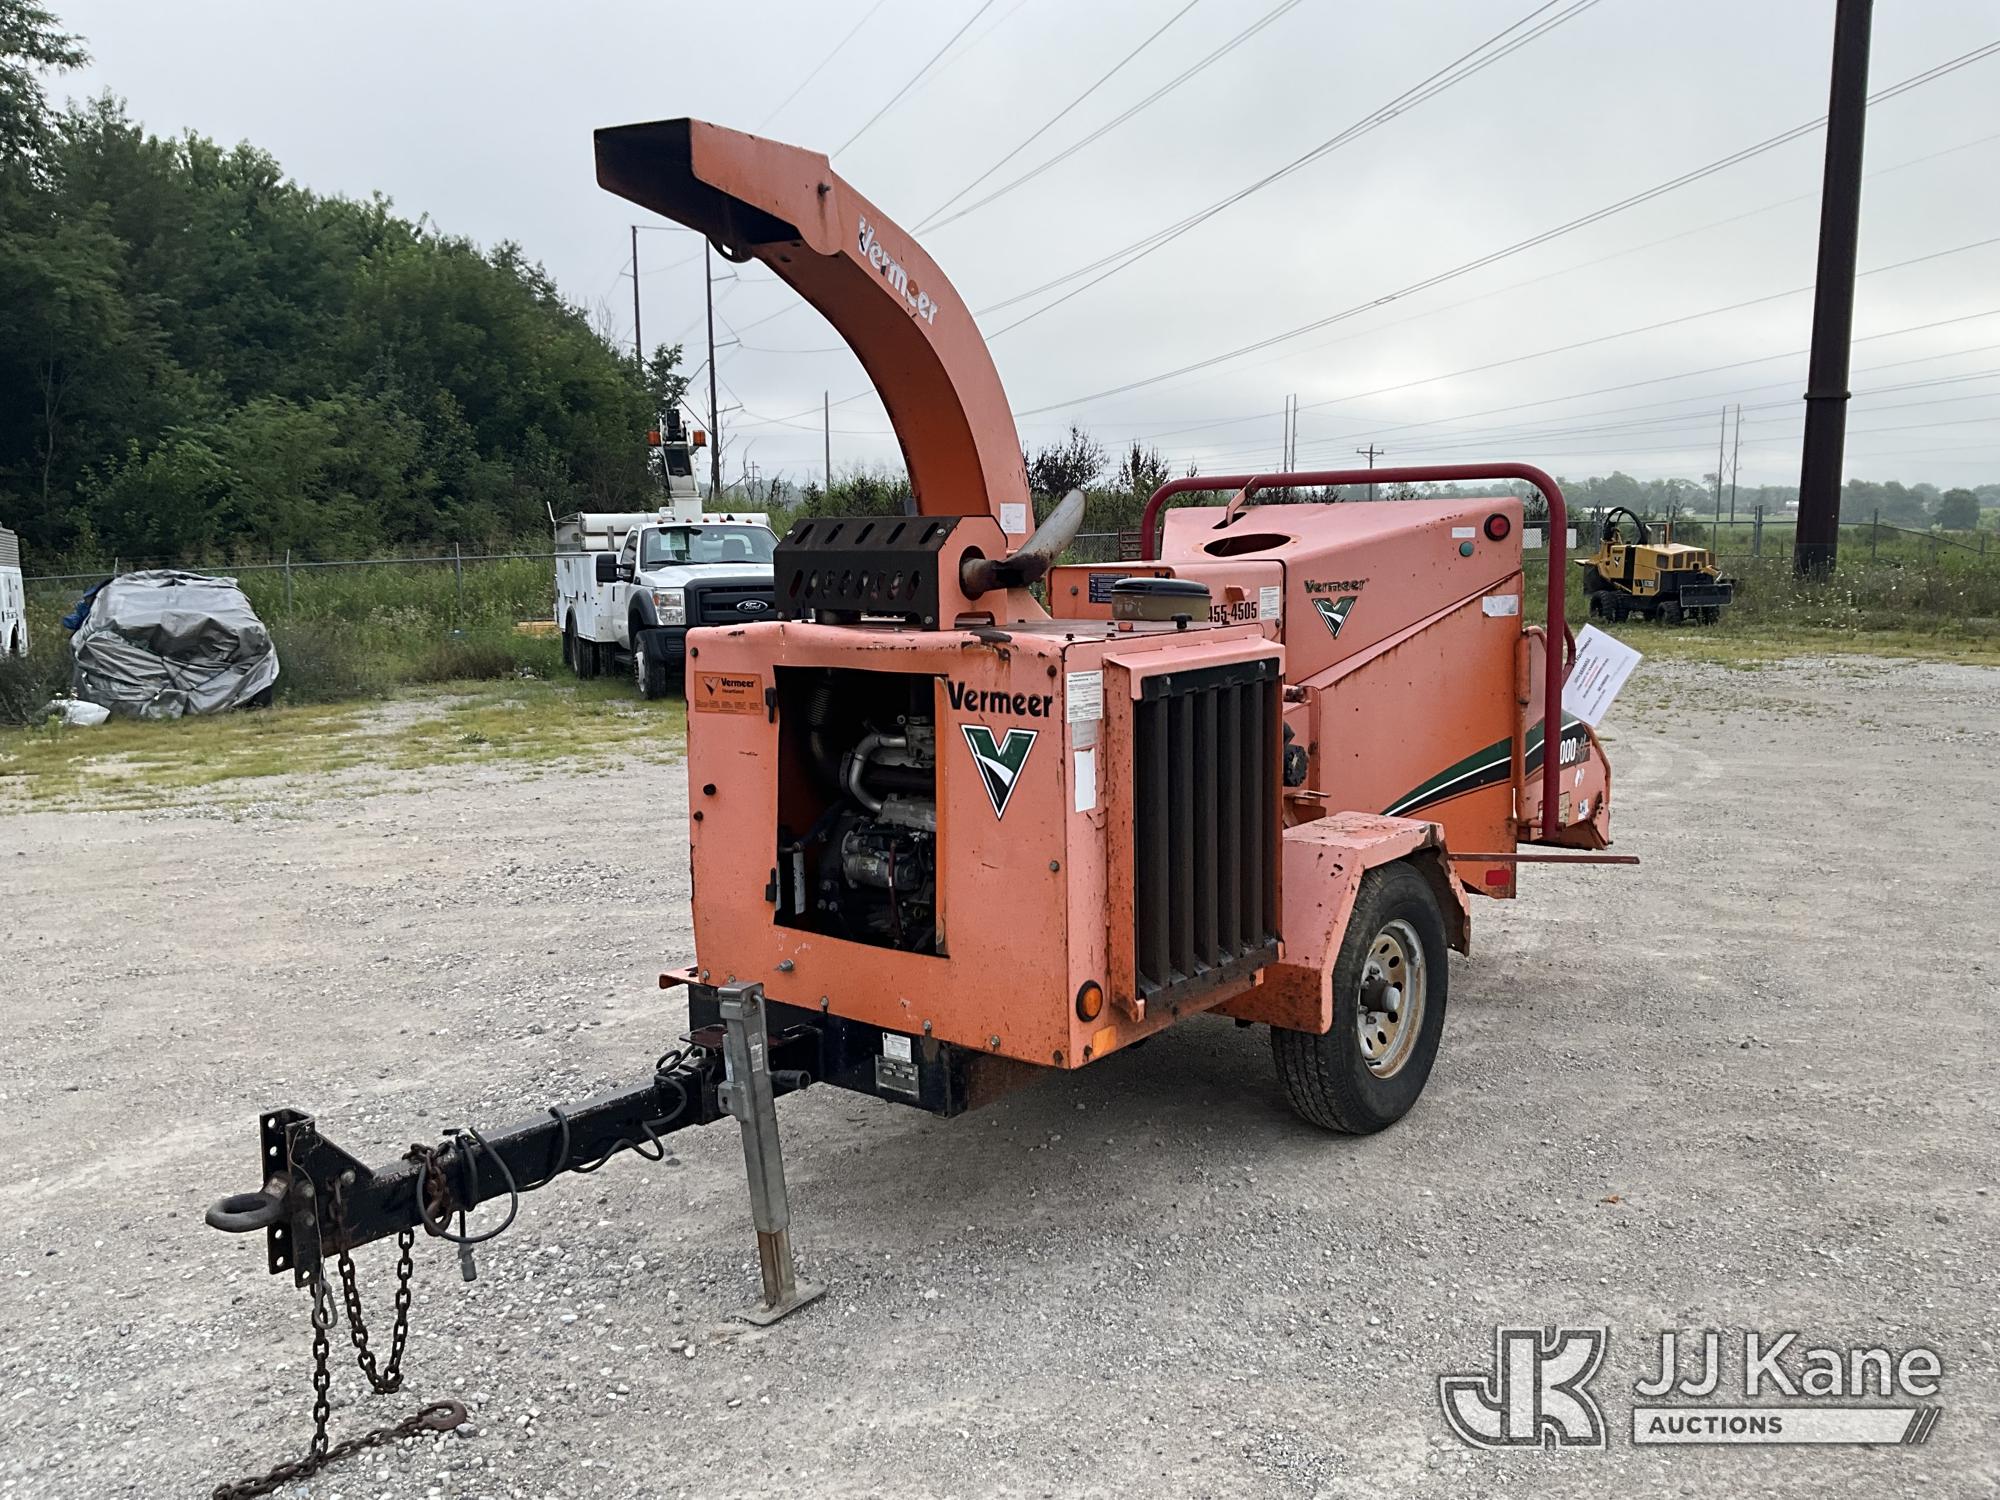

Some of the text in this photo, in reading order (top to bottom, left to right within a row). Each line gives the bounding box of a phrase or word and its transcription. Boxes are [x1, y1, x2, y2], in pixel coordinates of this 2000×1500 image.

[1304, 579, 1365, 594] Vermeer
[721, 677, 754, 688] Vermeer
[948, 681, 1053, 718] Vermeer
